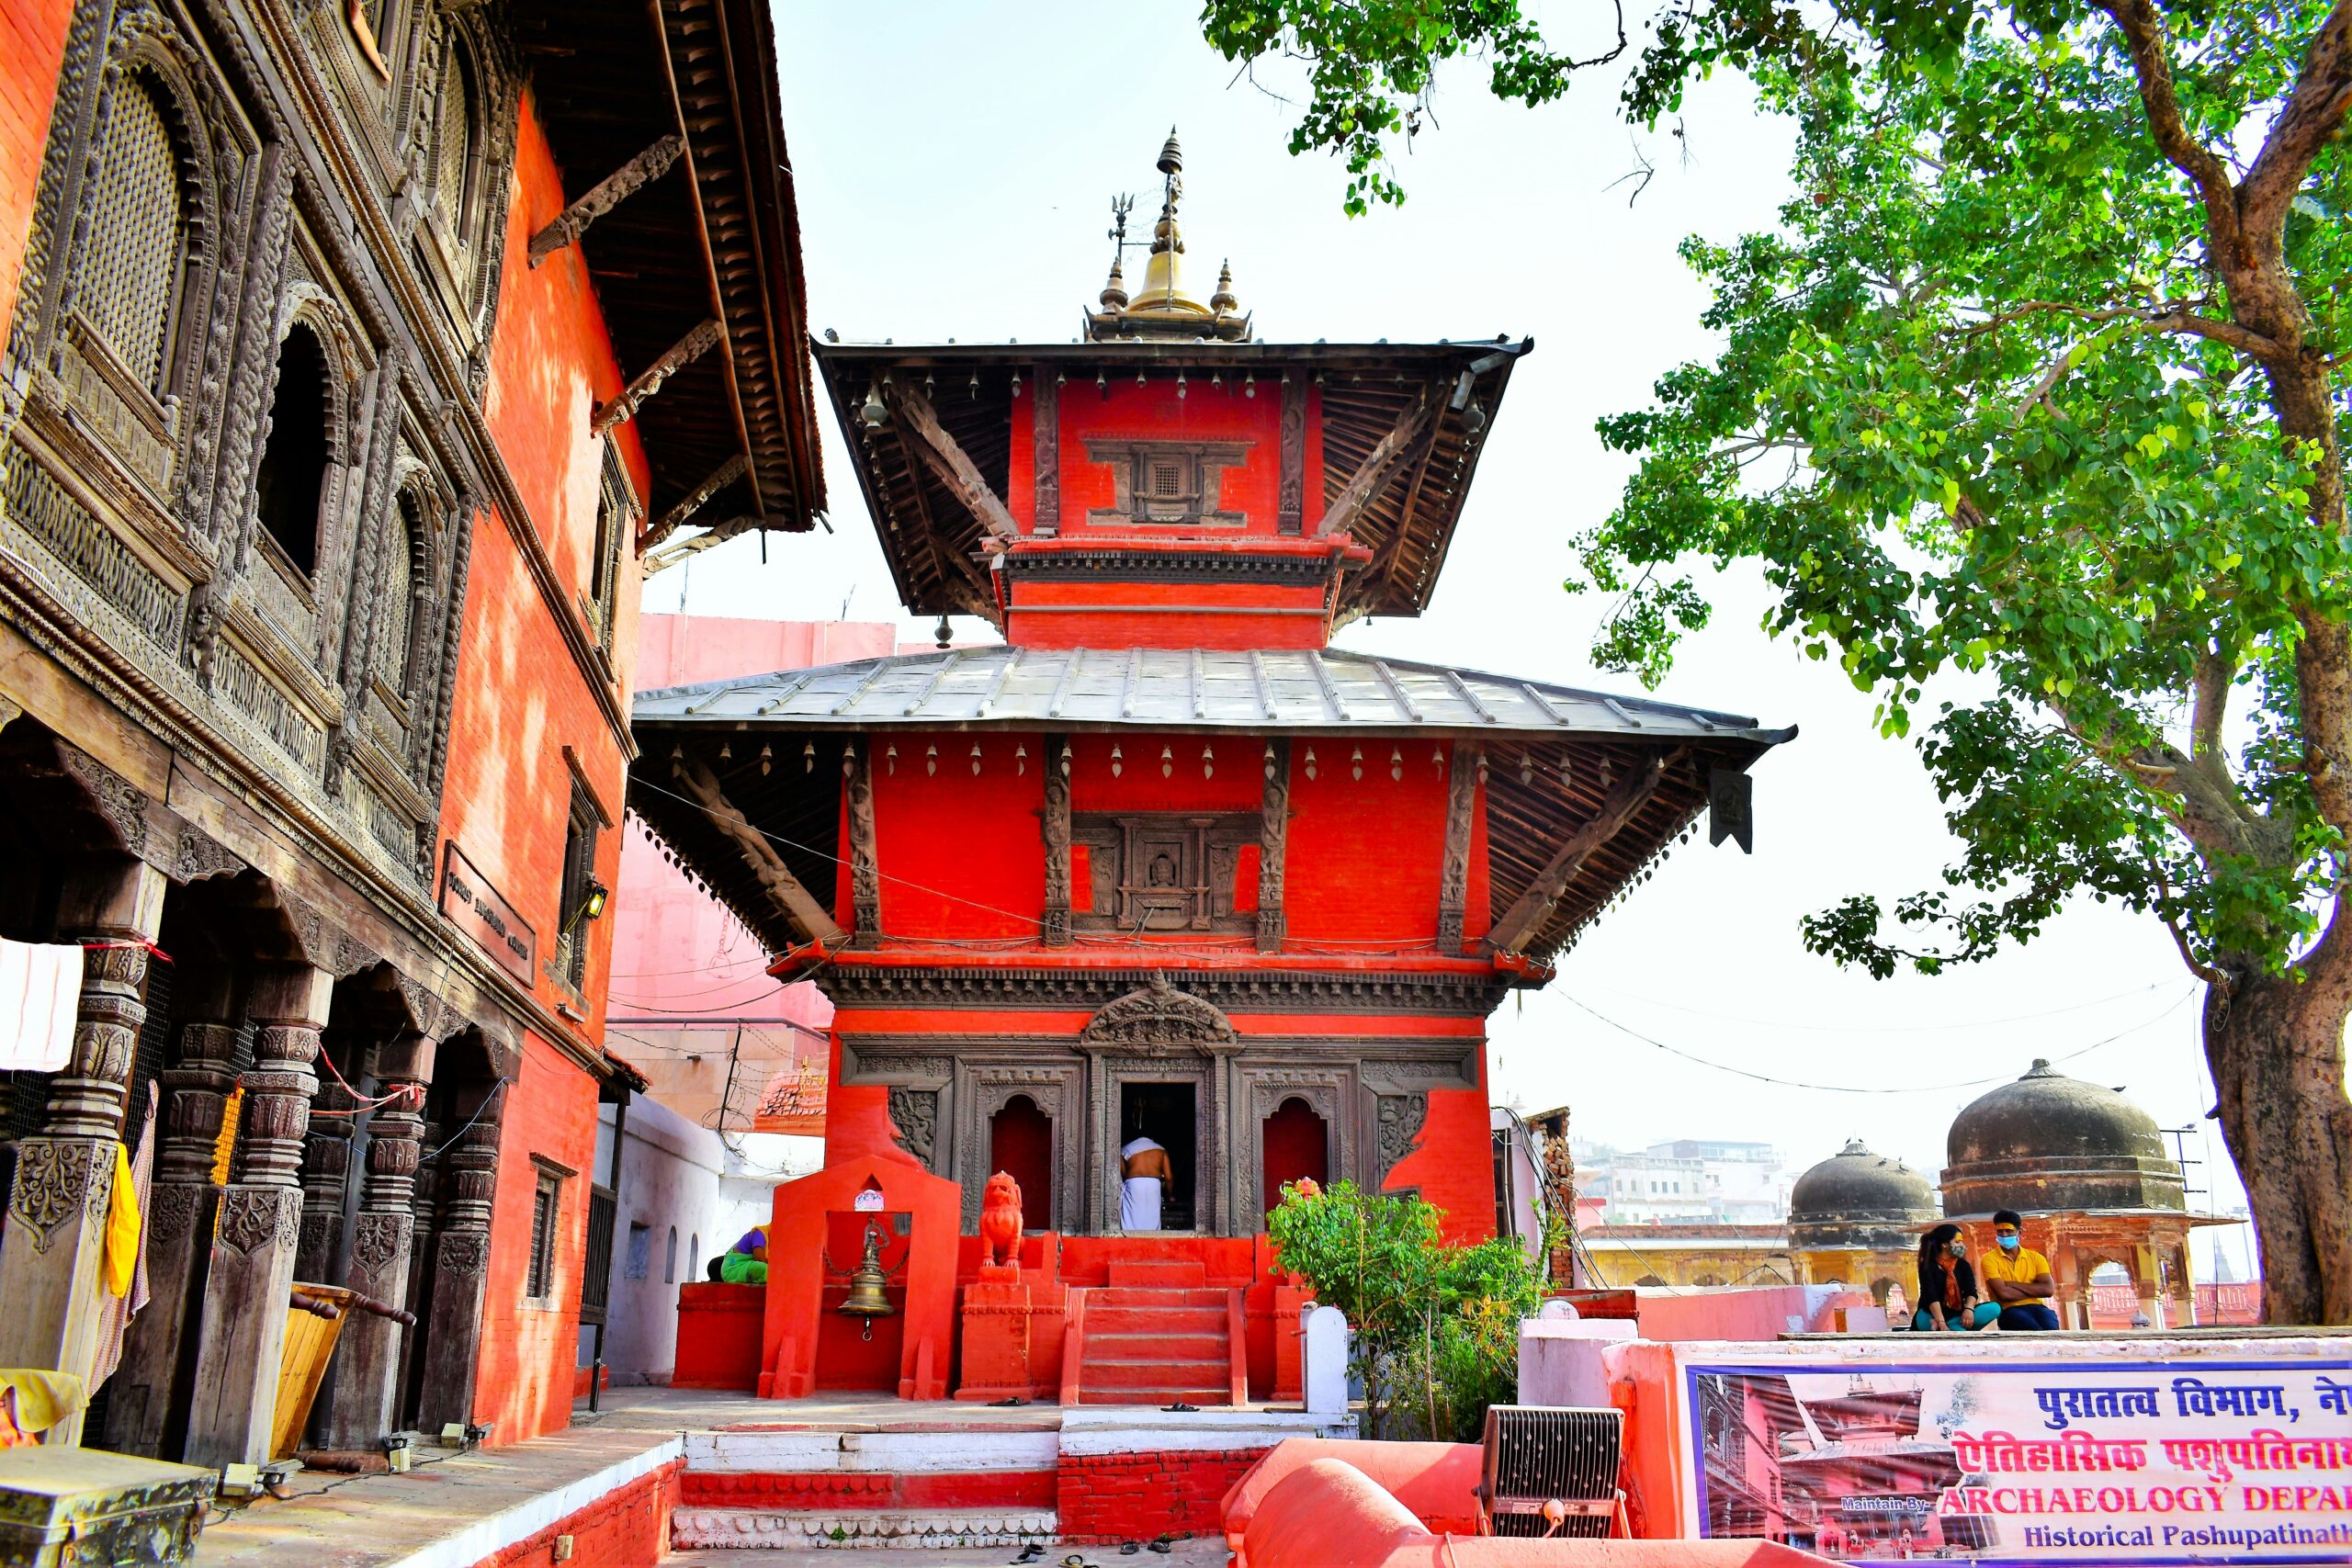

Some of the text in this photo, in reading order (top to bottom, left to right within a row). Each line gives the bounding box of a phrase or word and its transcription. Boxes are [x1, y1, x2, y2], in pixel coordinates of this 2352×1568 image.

[2033, 1376, 2352, 1430] पुरातत्व विभाग, ने
[1951, 1429, 2147, 1473] ऐतिहासिक
[1840, 1497, 1904, 1510] Maintain
[1941, 1484, 2352, 1515] ARCHAEOLOGY DEPA
[2024, 1524, 2154, 1548] Historical
